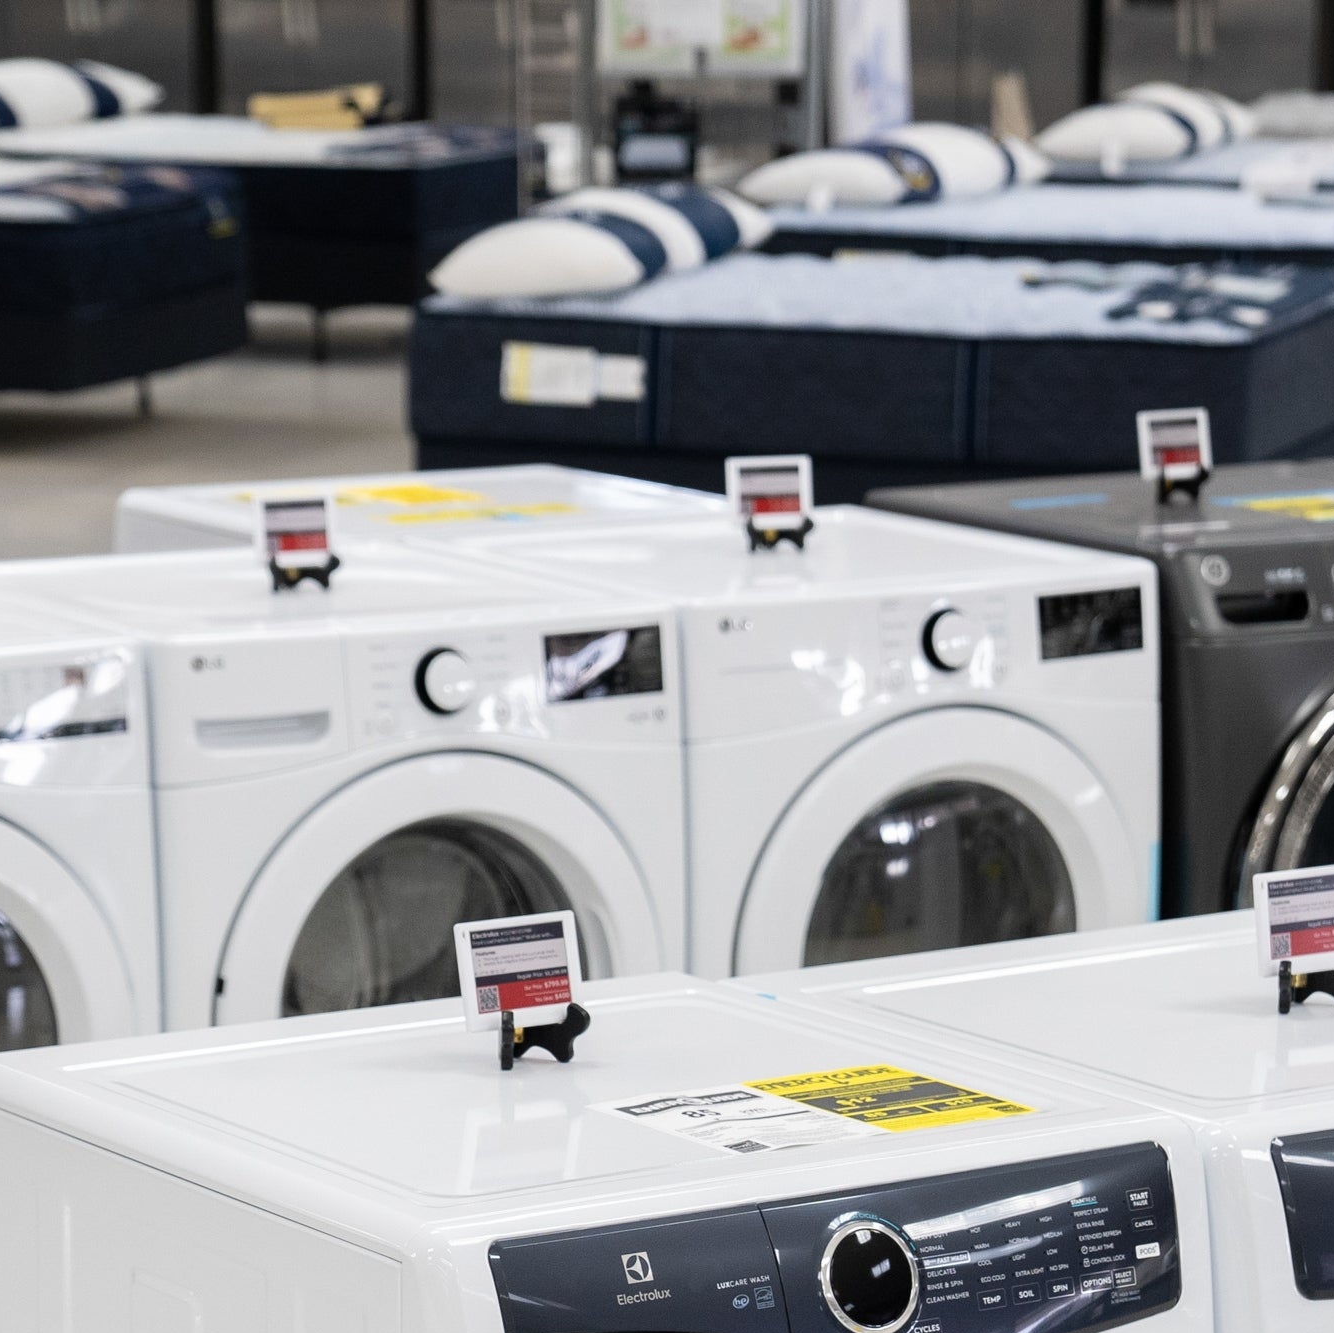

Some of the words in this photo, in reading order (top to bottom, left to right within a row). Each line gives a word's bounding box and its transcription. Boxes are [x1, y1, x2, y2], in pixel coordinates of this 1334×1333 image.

[682, 1109, 721, 1118] 85
[1130, 1191, 1148, 1201] START
[1074, 1209, 1093, 1217] PERFECT
[1134, 1220, 1154, 1228] CANCEL
[1079, 1233, 1102, 1241] EXTENDED
[1103, 1230, 1122, 1238] REFRESH
[920, 1245, 945, 1253] NORMAL
[1088, 1245, 1103, 1253] DELAY
[937, 1255, 949, 1263] FAST
[949, 1253, 967, 1261] WASH
[1012, 1253, 1026, 1261] LIGHT
[1091, 1257, 1112, 1265] CONTROL
[1112, 1254, 1125, 1262] LOCK
[1015, 1269, 1030, 1277] EXTRA
[1030, 1267, 1044, 1275] LIGHT
[1058, 1263, 1069, 1271] SPIN
[927, 1268, 957, 1278] DELICATES
[716, 1278, 748, 1290] LUXCARE
[749, 1275, 770, 1284] WASH
[927, 1282, 944, 1290] RINSE
[1083, 1276, 1112, 1288] OPTIONS
[1053, 1284, 1068, 1293] SPIN
[617, 1287, 671, 1306] Electrolux
[926, 1295, 945, 1304] CLEAN
[947, 1291, 970, 1301] WASHER
[1019, 1290, 1034, 1299] SOIL
[983, 1295, 1001, 1305] TEMP
